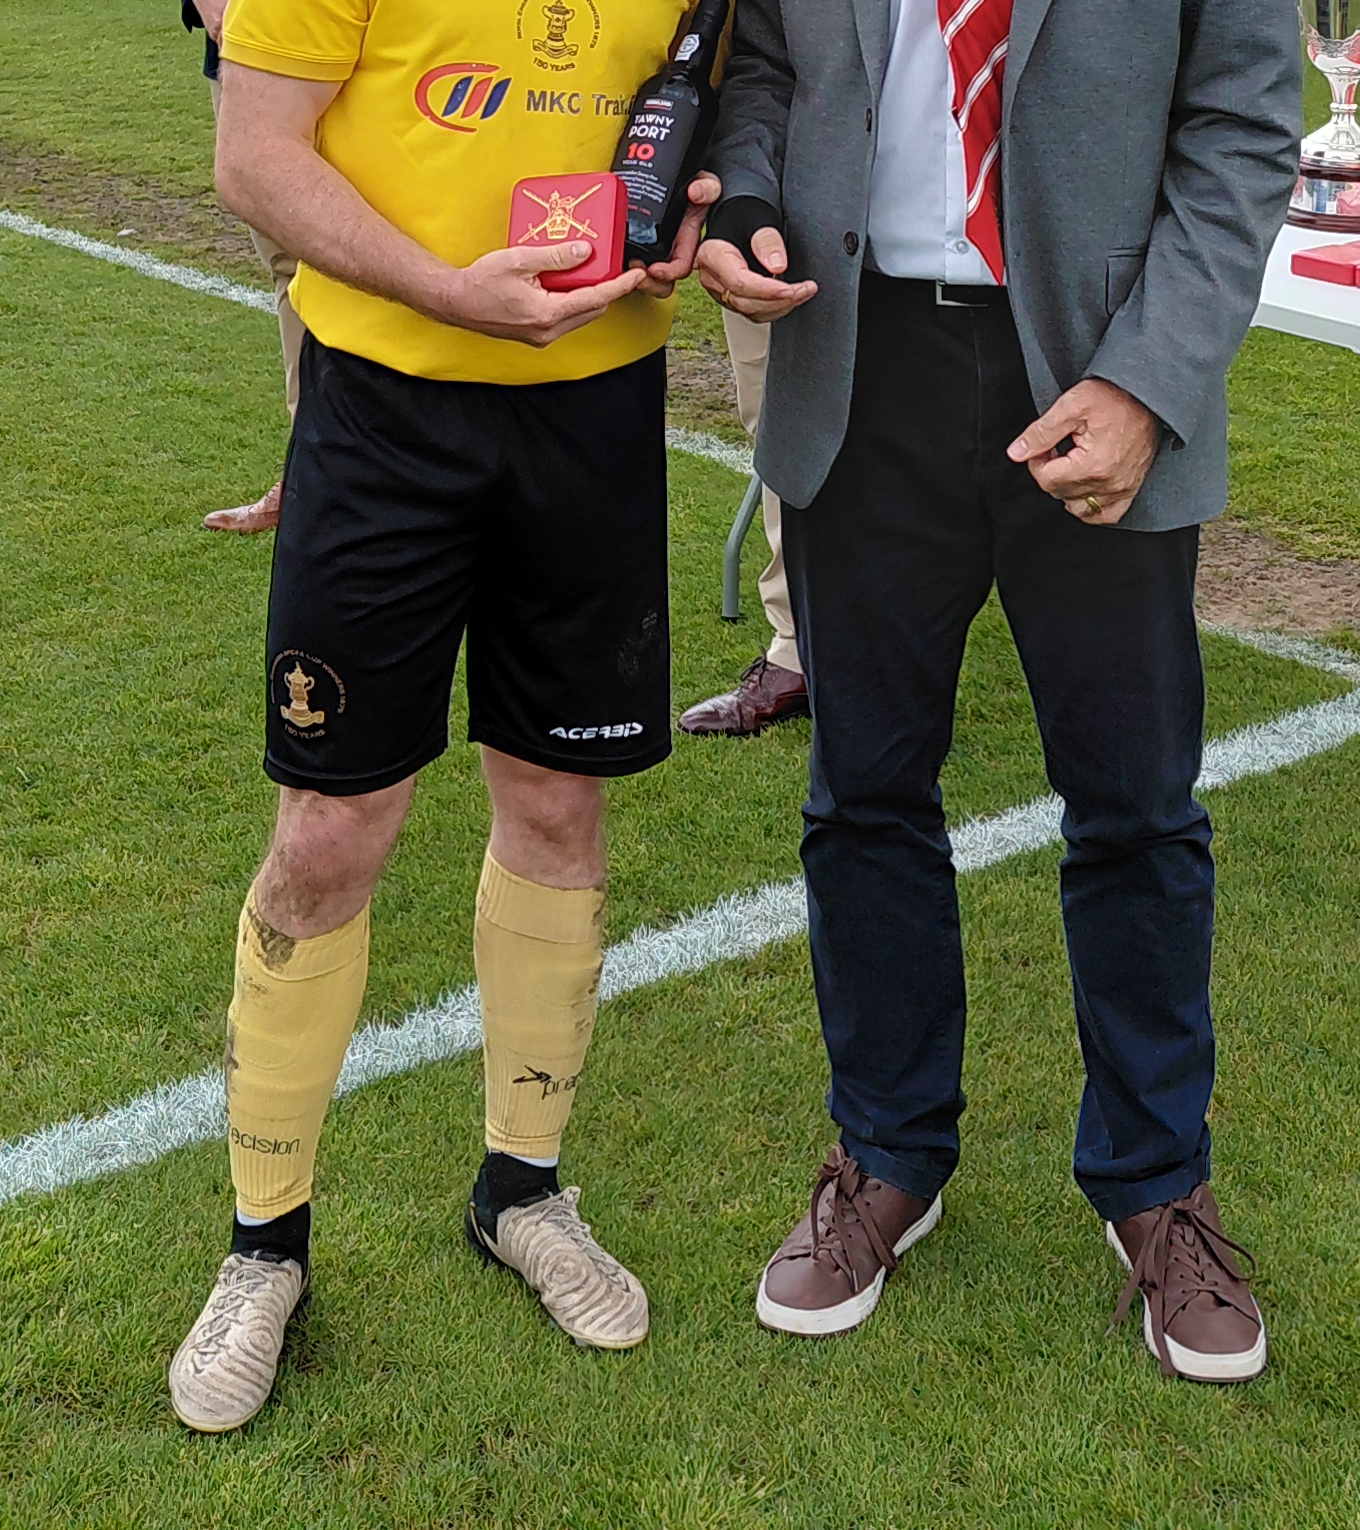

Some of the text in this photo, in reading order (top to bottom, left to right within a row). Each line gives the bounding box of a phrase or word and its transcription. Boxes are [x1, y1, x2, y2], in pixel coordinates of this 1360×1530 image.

[533, 57, 576, 72] 150 YEARS
[526, 89, 582, 115] MKC
[635, 114, 675, 127] TAWNY
[628, 125, 671, 141] PORT
[627, 142, 655, 160] 10
